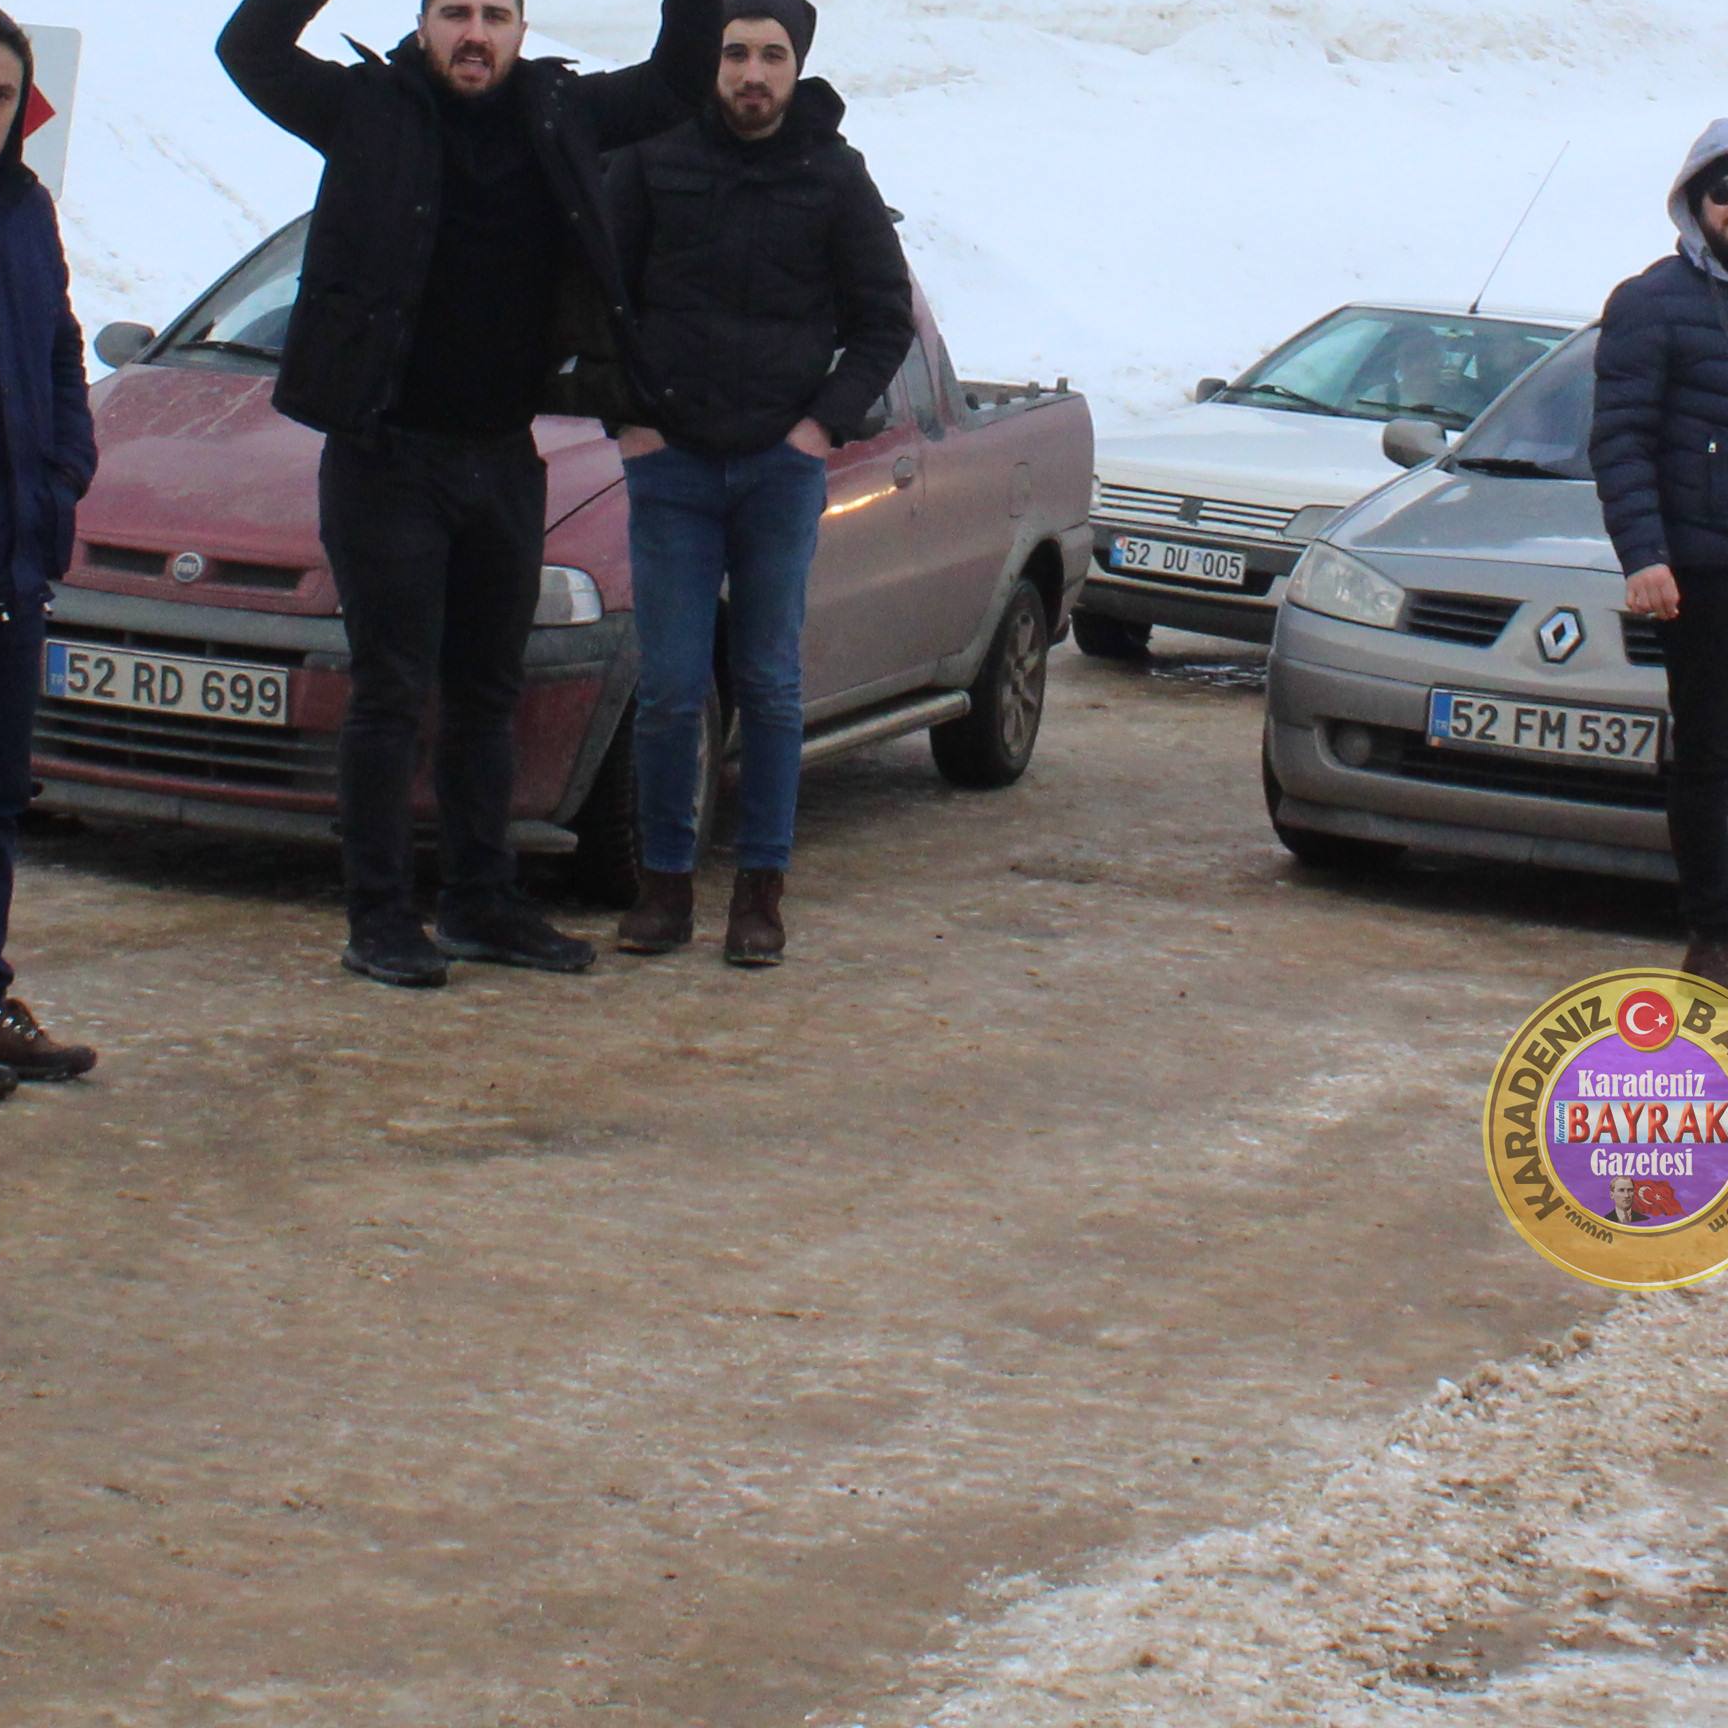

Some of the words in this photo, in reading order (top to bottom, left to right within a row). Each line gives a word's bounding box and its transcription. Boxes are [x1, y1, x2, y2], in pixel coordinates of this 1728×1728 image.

[1125, 541, 1151, 567] 52
[1163, 547, 1190, 572] DU
[1202, 553, 1242, 580] 005
[68, 652, 116, 699] 52
[132, 662, 184, 707] RD
[201, 670, 283, 718] 699
[1451, 699, 1499, 742] 52
[1513, 707, 1567, 750] FM
[1578, 714, 1657, 758] 537
